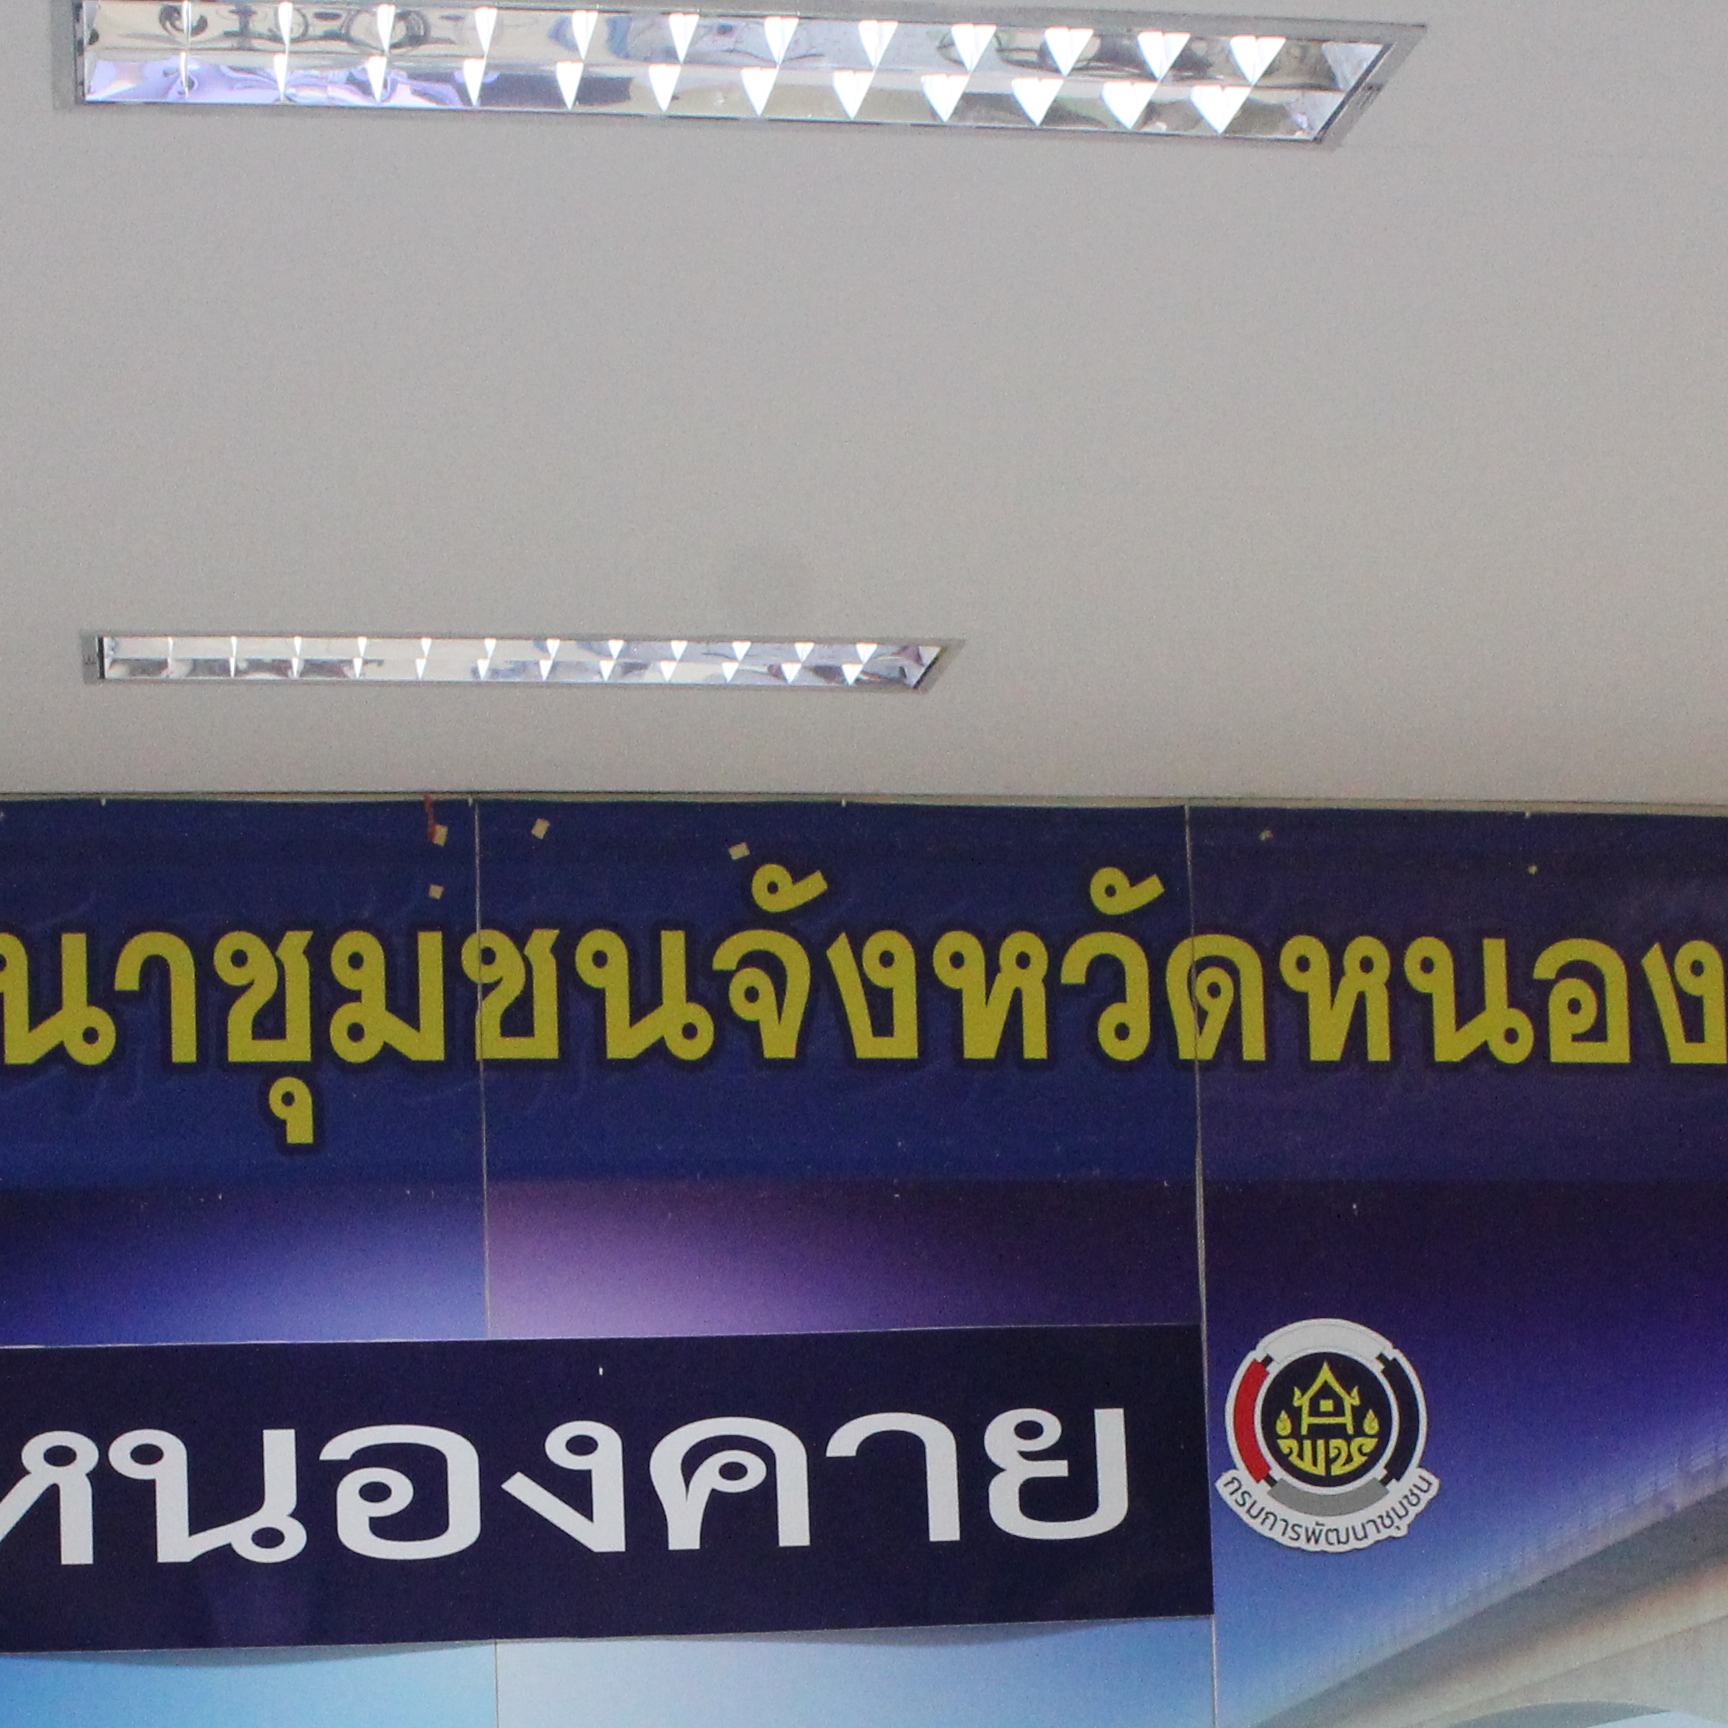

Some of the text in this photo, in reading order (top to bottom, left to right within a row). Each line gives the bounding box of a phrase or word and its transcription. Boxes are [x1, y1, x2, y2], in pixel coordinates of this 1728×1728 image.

[1222, 1473, 1433, 1547] กรมการพัฒนาชุมชน
